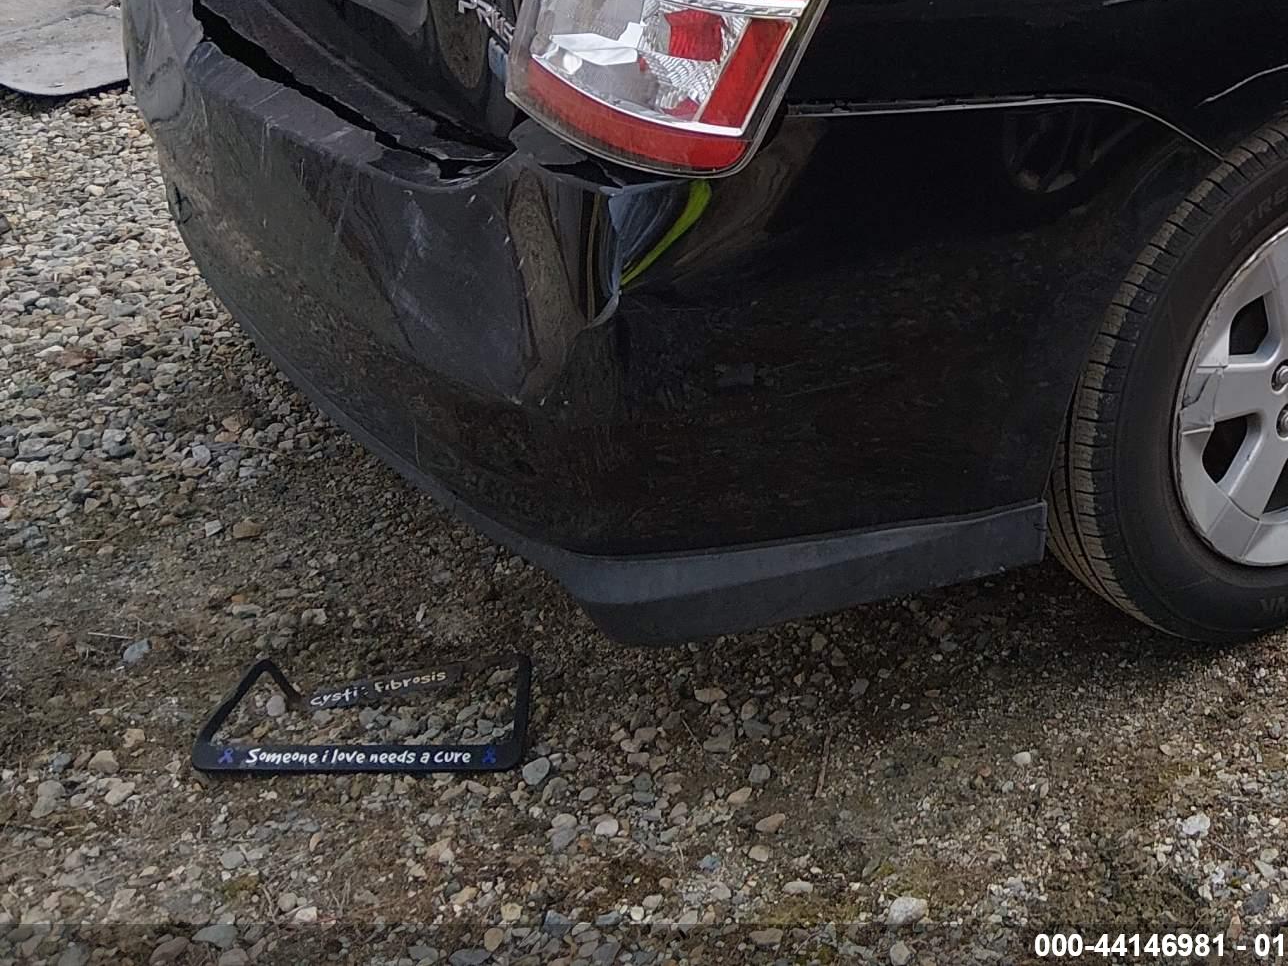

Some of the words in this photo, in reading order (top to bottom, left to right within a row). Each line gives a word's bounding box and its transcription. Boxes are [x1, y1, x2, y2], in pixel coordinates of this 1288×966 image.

[245, 747, 317, 765] Someone
[321, 749, 330, 764] i
[331, 748, 365, 764] love
[369, 749, 417, 764] needs
[420, 752, 429, 764] a
[434, 751, 472, 764] cure
